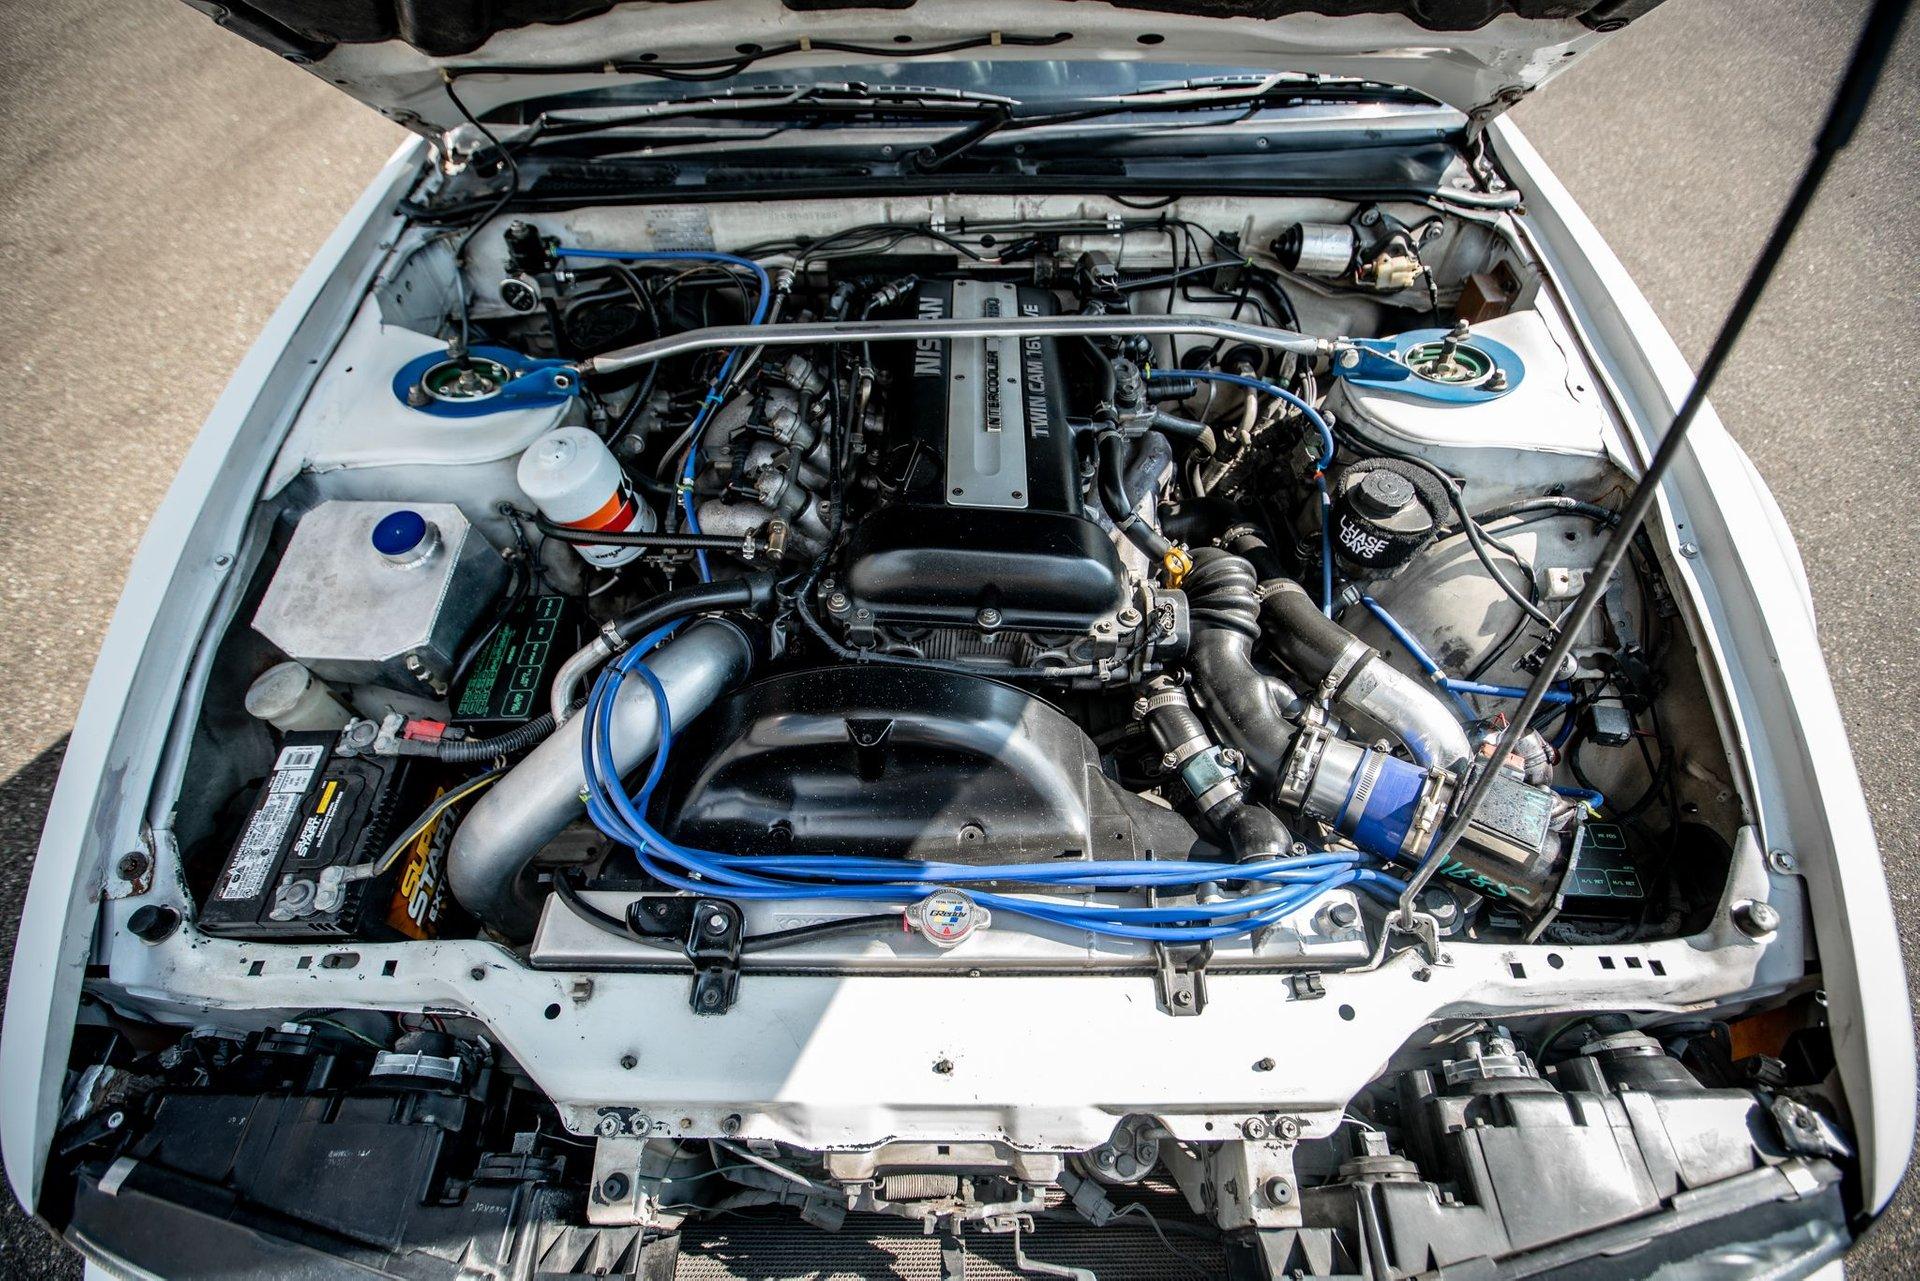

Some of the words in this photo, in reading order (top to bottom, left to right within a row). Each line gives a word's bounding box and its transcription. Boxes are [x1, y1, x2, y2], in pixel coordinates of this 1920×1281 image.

[914, 297, 944, 376] NISAN
[986, 350, 1001, 430] INTERCOOLER
[1026, 361, 1046, 396] CAM
[1029, 396, 1049, 439] TWIN
[1339, 527, 1375, 559] BAYS
[1340, 514, 1389, 552] CHASE
[294, 817, 315, 852] SUPER
[929, 909, 968, 919] GReddy
